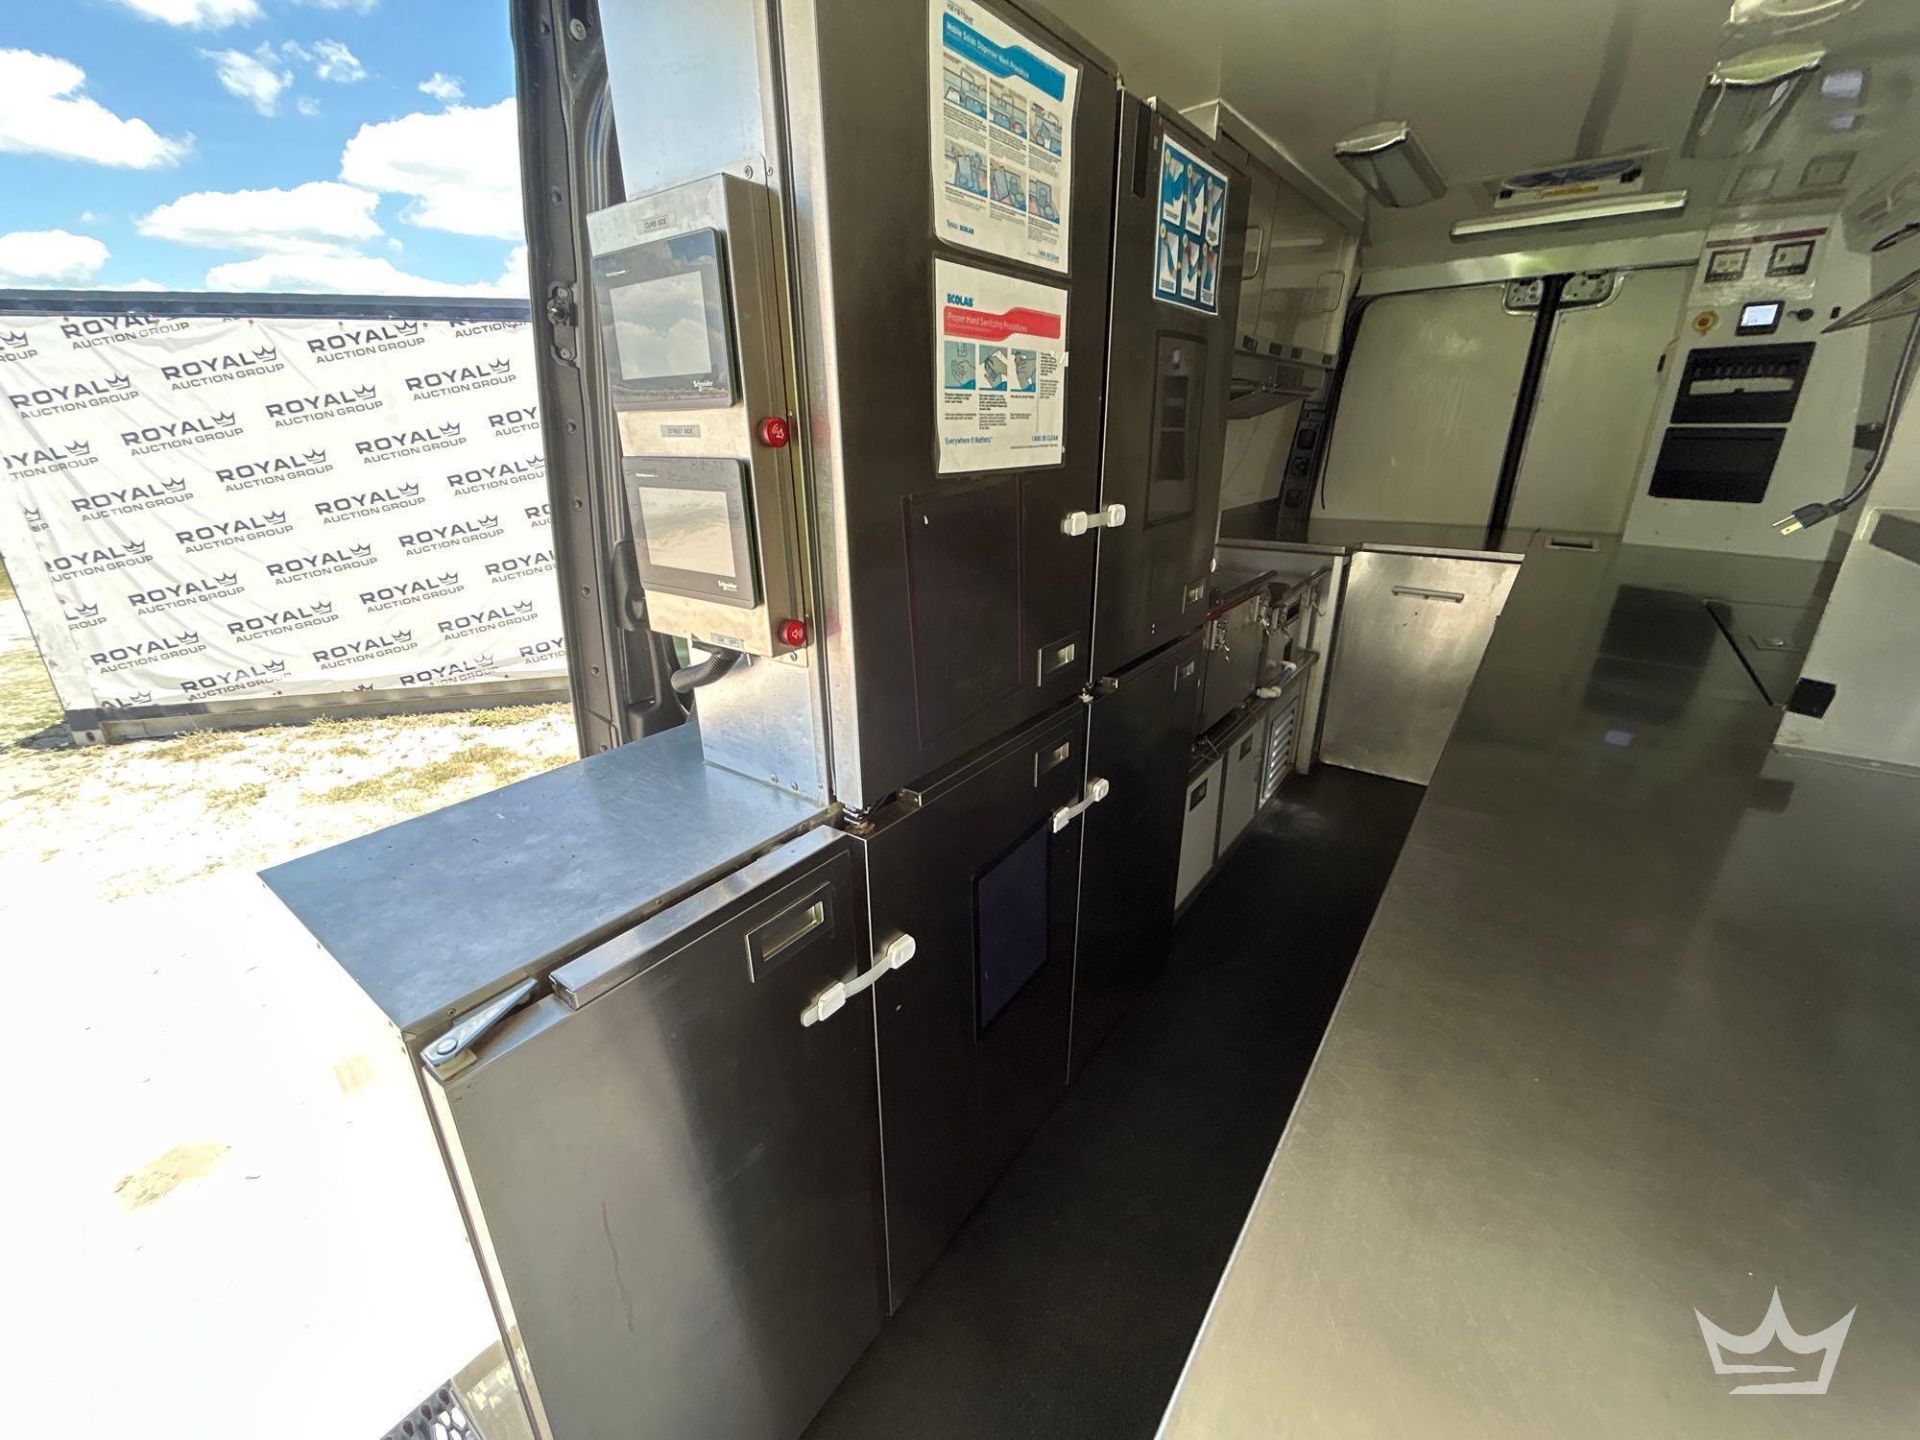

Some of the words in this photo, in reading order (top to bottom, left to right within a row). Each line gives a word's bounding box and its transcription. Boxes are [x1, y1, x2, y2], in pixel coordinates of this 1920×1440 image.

[947, 293, 974, 307] ECOLAB
[72, 332, 136, 350] AUCTION
[138, 322, 190, 339] GROUP
[307, 325, 397, 353] ROYAL
[455, 321, 511, 338] AUCTION
[316, 346, 377, 364] AUCTION
[377, 337, 425, 352] GROUP
[161, 352, 256, 380] ROYAL
[171, 372, 234, 391] AUCTION
[236, 363, 285, 379] GROUP
[405, 365, 491, 391] ROYAL
[9, 380, 109, 409] ROYAL
[413, 384, 470, 401] AUCTION
[472, 374, 516, 390] GROUP
[19, 401, 87, 420] AUCTION
[90, 391, 139, 407] GROUP
[265, 390, 356, 418] ROYAL
[275, 410, 335, 428] AUCTION
[337, 400, 383, 417] GROUP
[121, 418, 215, 446] ROYAL
[131, 438, 193, 456] AUCTION
[195, 427, 244, 444] GROUP
[355, 428, 441, 455] ROYAL
[48, 457, 99, 473] GROUP
[363, 447, 421, 465] AUCTION
[423, 437, 467, 452] GROUP
[215, 452, 306, 483] ROYAL
[225, 474, 285, 492] AUCTION
[288, 464, 334, 480] GROUP
[447, 461, 528, 488] ROYAL
[71, 484, 165, 512] ROYAL
[315, 488, 400, 515] ROYAL
[454, 479, 508, 496] AUCTION
[82, 503, 143, 522] AUCTION
[146, 492, 194, 509] GROUP
[323, 508, 380, 525] AUCTION
[382, 497, 426, 512] GROUP
[176, 517, 266, 544] ROYAL
[185, 536, 245, 554] AUCTION
[247, 525, 293, 541] GROUP
[398, 521, 480, 548] ROYAL
[406, 540, 460, 556] AUCTION
[463, 528, 505, 543] GROUP
[106, 555, 154, 571] GROUP
[266, 550, 352, 577] ROYAL
[274, 566, 332, 586] AUCTION
[334, 557, 378, 572] GROUP
[491, 567, 543, 584] AUCTION
[128, 578, 218, 607] ROYAL
[137, 597, 197, 615] AUCTION
[199, 586, 245, 602] GROUP
[359, 578, 440, 605] ROYAL
[367, 596, 421, 613] AUCTION
[422, 585, 465, 600] GROUP
[226, 607, 313, 635] ROYAL
[235, 624, 293, 643] AUCTION
[295, 614, 339, 630] GROUP
[437, 607, 515, 633] ROYAL
[444, 625, 495, 641] AUCTION
[497, 613, 538, 628] GROUP
[90, 637, 179, 665] ROYAL
[100, 656, 159, 674] AUCTION
[161, 644, 206, 660] GROUP
[313, 635, 394, 662] ROYAL
[320, 653, 375, 671] AUCTION
[376, 642, 418, 658] GROUP
[180, 666, 266, 693] ROYAL
[400, 660, 476, 686] ROYAL
